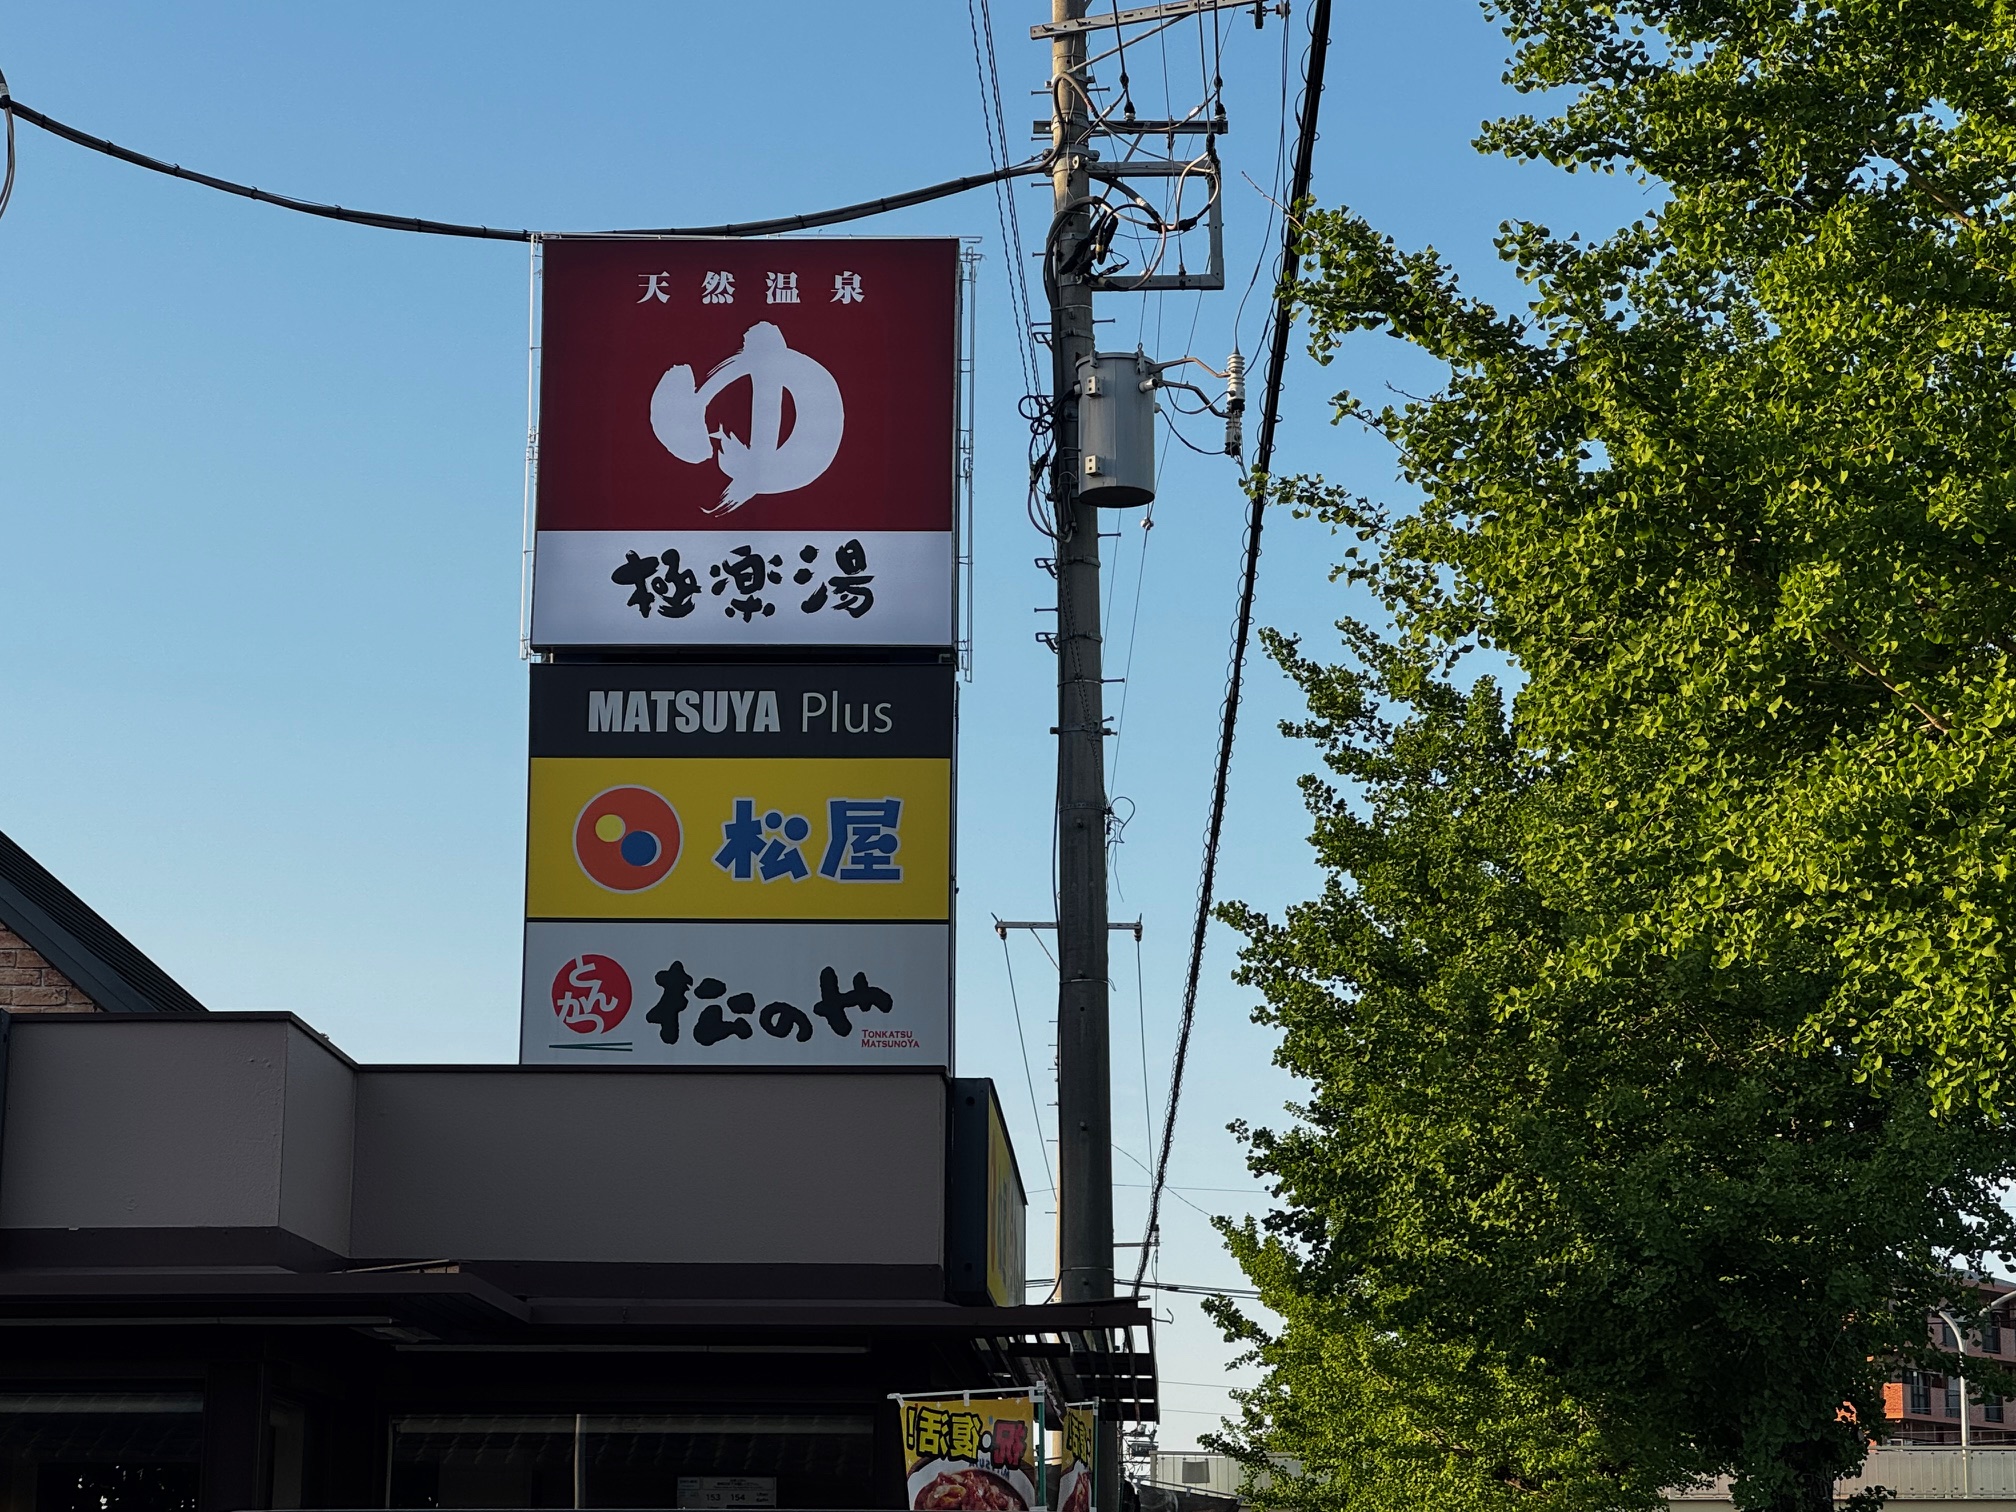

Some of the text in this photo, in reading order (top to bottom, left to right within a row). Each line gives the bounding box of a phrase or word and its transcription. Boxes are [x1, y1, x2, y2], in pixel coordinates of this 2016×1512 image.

[637, 271, 866, 304] 天然温泉
[650, 321, 845, 517] ゆ
[611, 538, 875, 622] 極楽湯
[588, 690, 893, 734] MATSUYA Plus
[712, 796, 904, 883] 松屋
[646, 960, 893, 1046] 松のや
[706, 1493, 721, 1501] 153
[731, 1493, 746, 1501] 154
